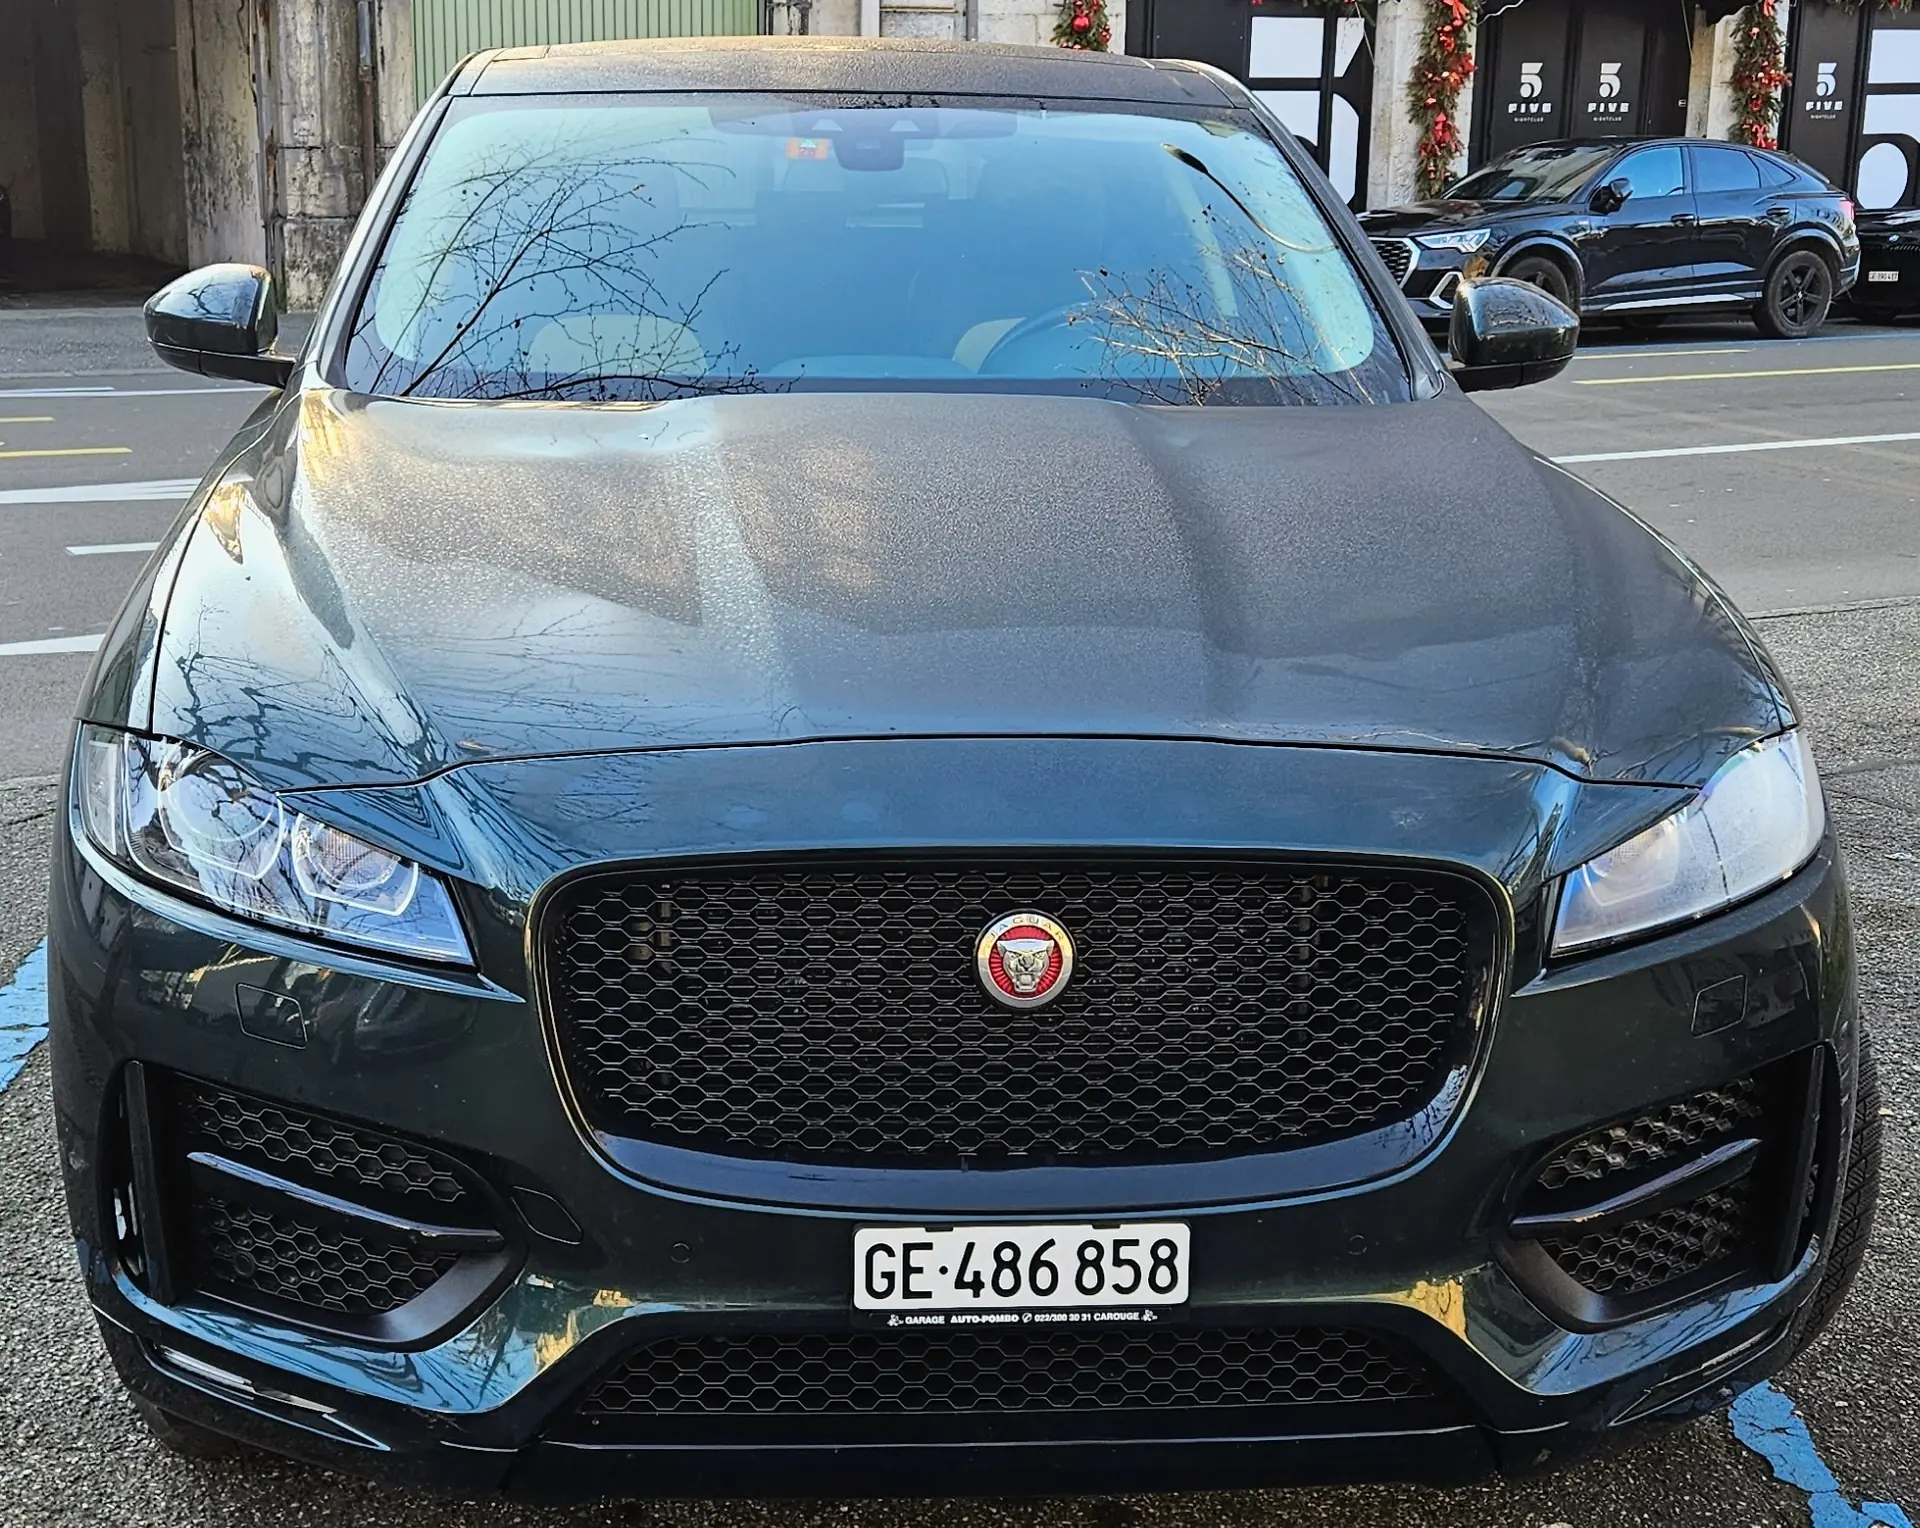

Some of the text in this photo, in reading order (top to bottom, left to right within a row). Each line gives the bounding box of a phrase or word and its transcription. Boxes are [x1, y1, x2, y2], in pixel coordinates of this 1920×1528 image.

[1520, 62, 1543, 98] 5
[1599, 62, 1622, 98] 5
[1816, 62, 1837, 97] 5
[1508, 102, 1552, 113] FIVE
[1587, 102, 1630, 113] FIVE
[1805, 100, 1843, 111] FIVE
[1074, 1237, 1179, 1296] 858
[904, 1315, 946, 1325] GARAGE
[950, 1314, 1020, 1324] AUTO-POMBO
[1081, 1312, 1092, 1321] 31
[1093, 1311, 1140, 1321] CAROUGE
